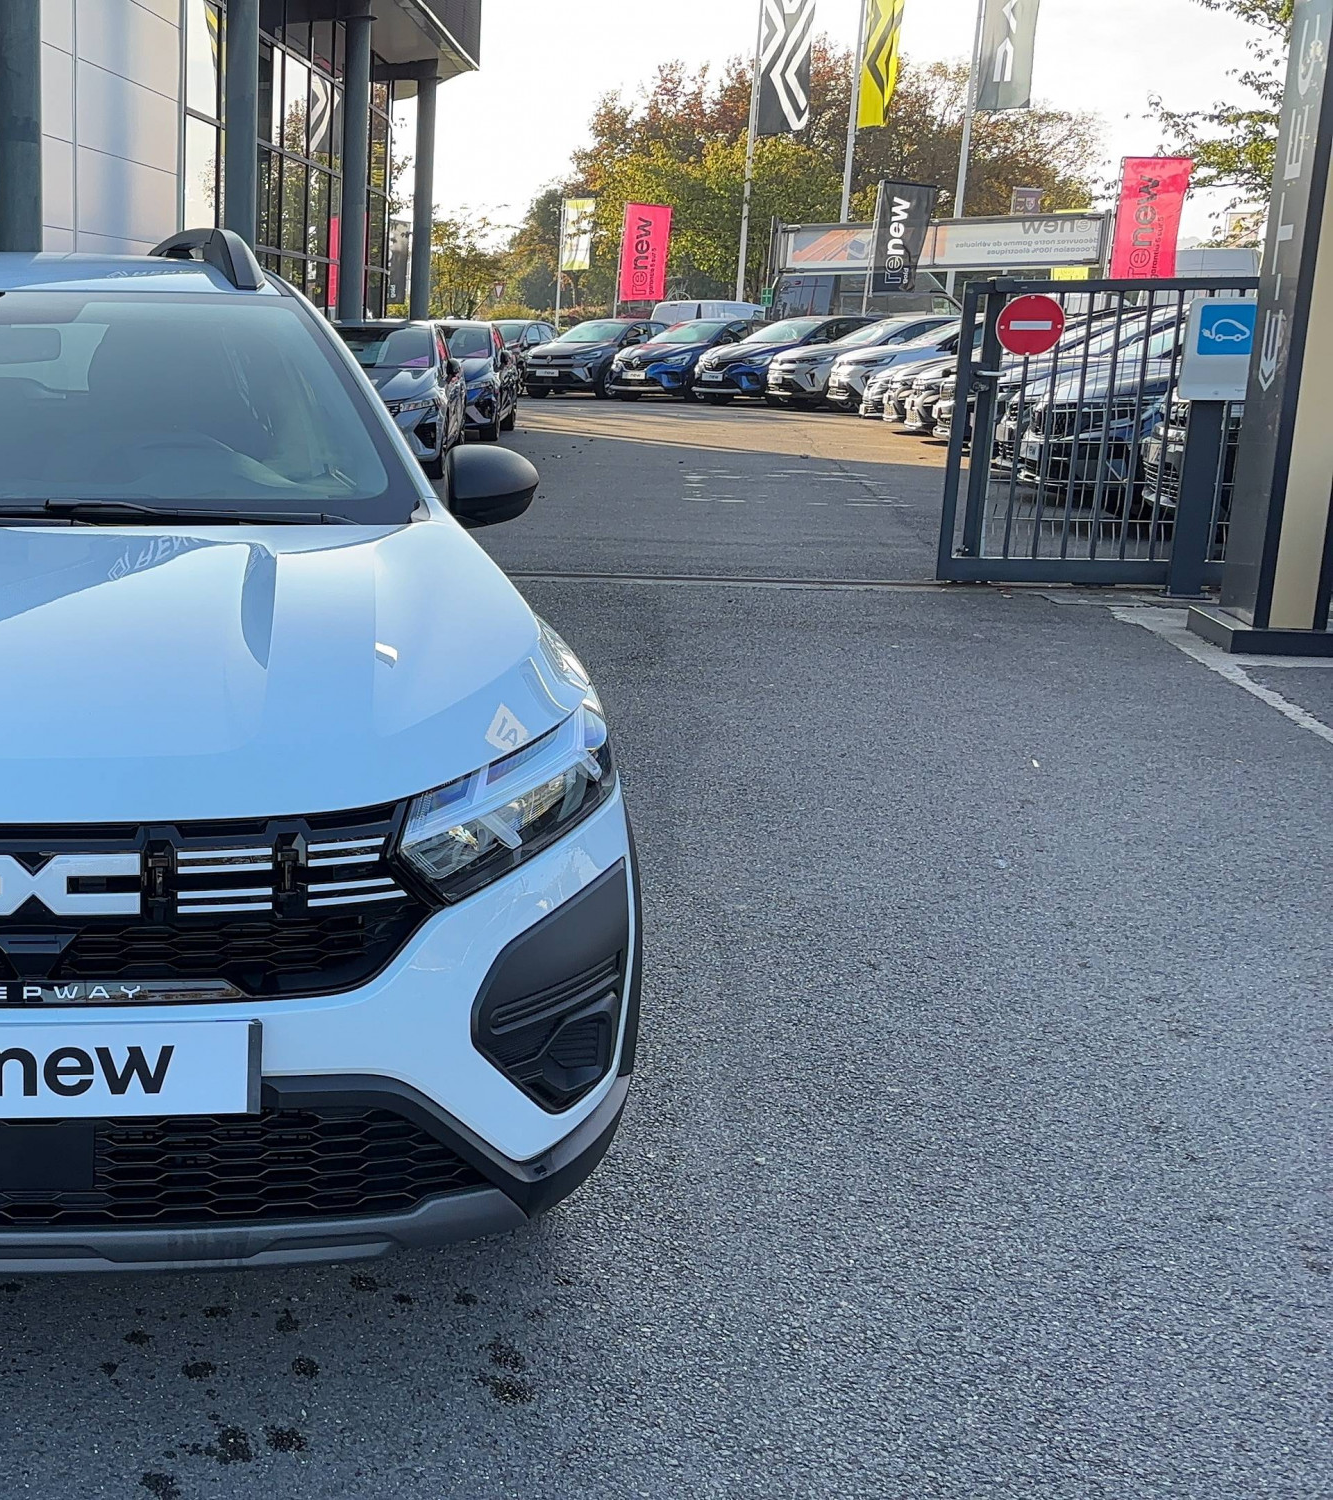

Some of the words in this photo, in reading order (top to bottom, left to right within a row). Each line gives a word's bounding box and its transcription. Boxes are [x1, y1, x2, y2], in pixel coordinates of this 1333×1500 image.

[632, 217, 652, 295] renew
[884, 196, 911, 284] renew
[1127, 174, 1160, 278] renew
